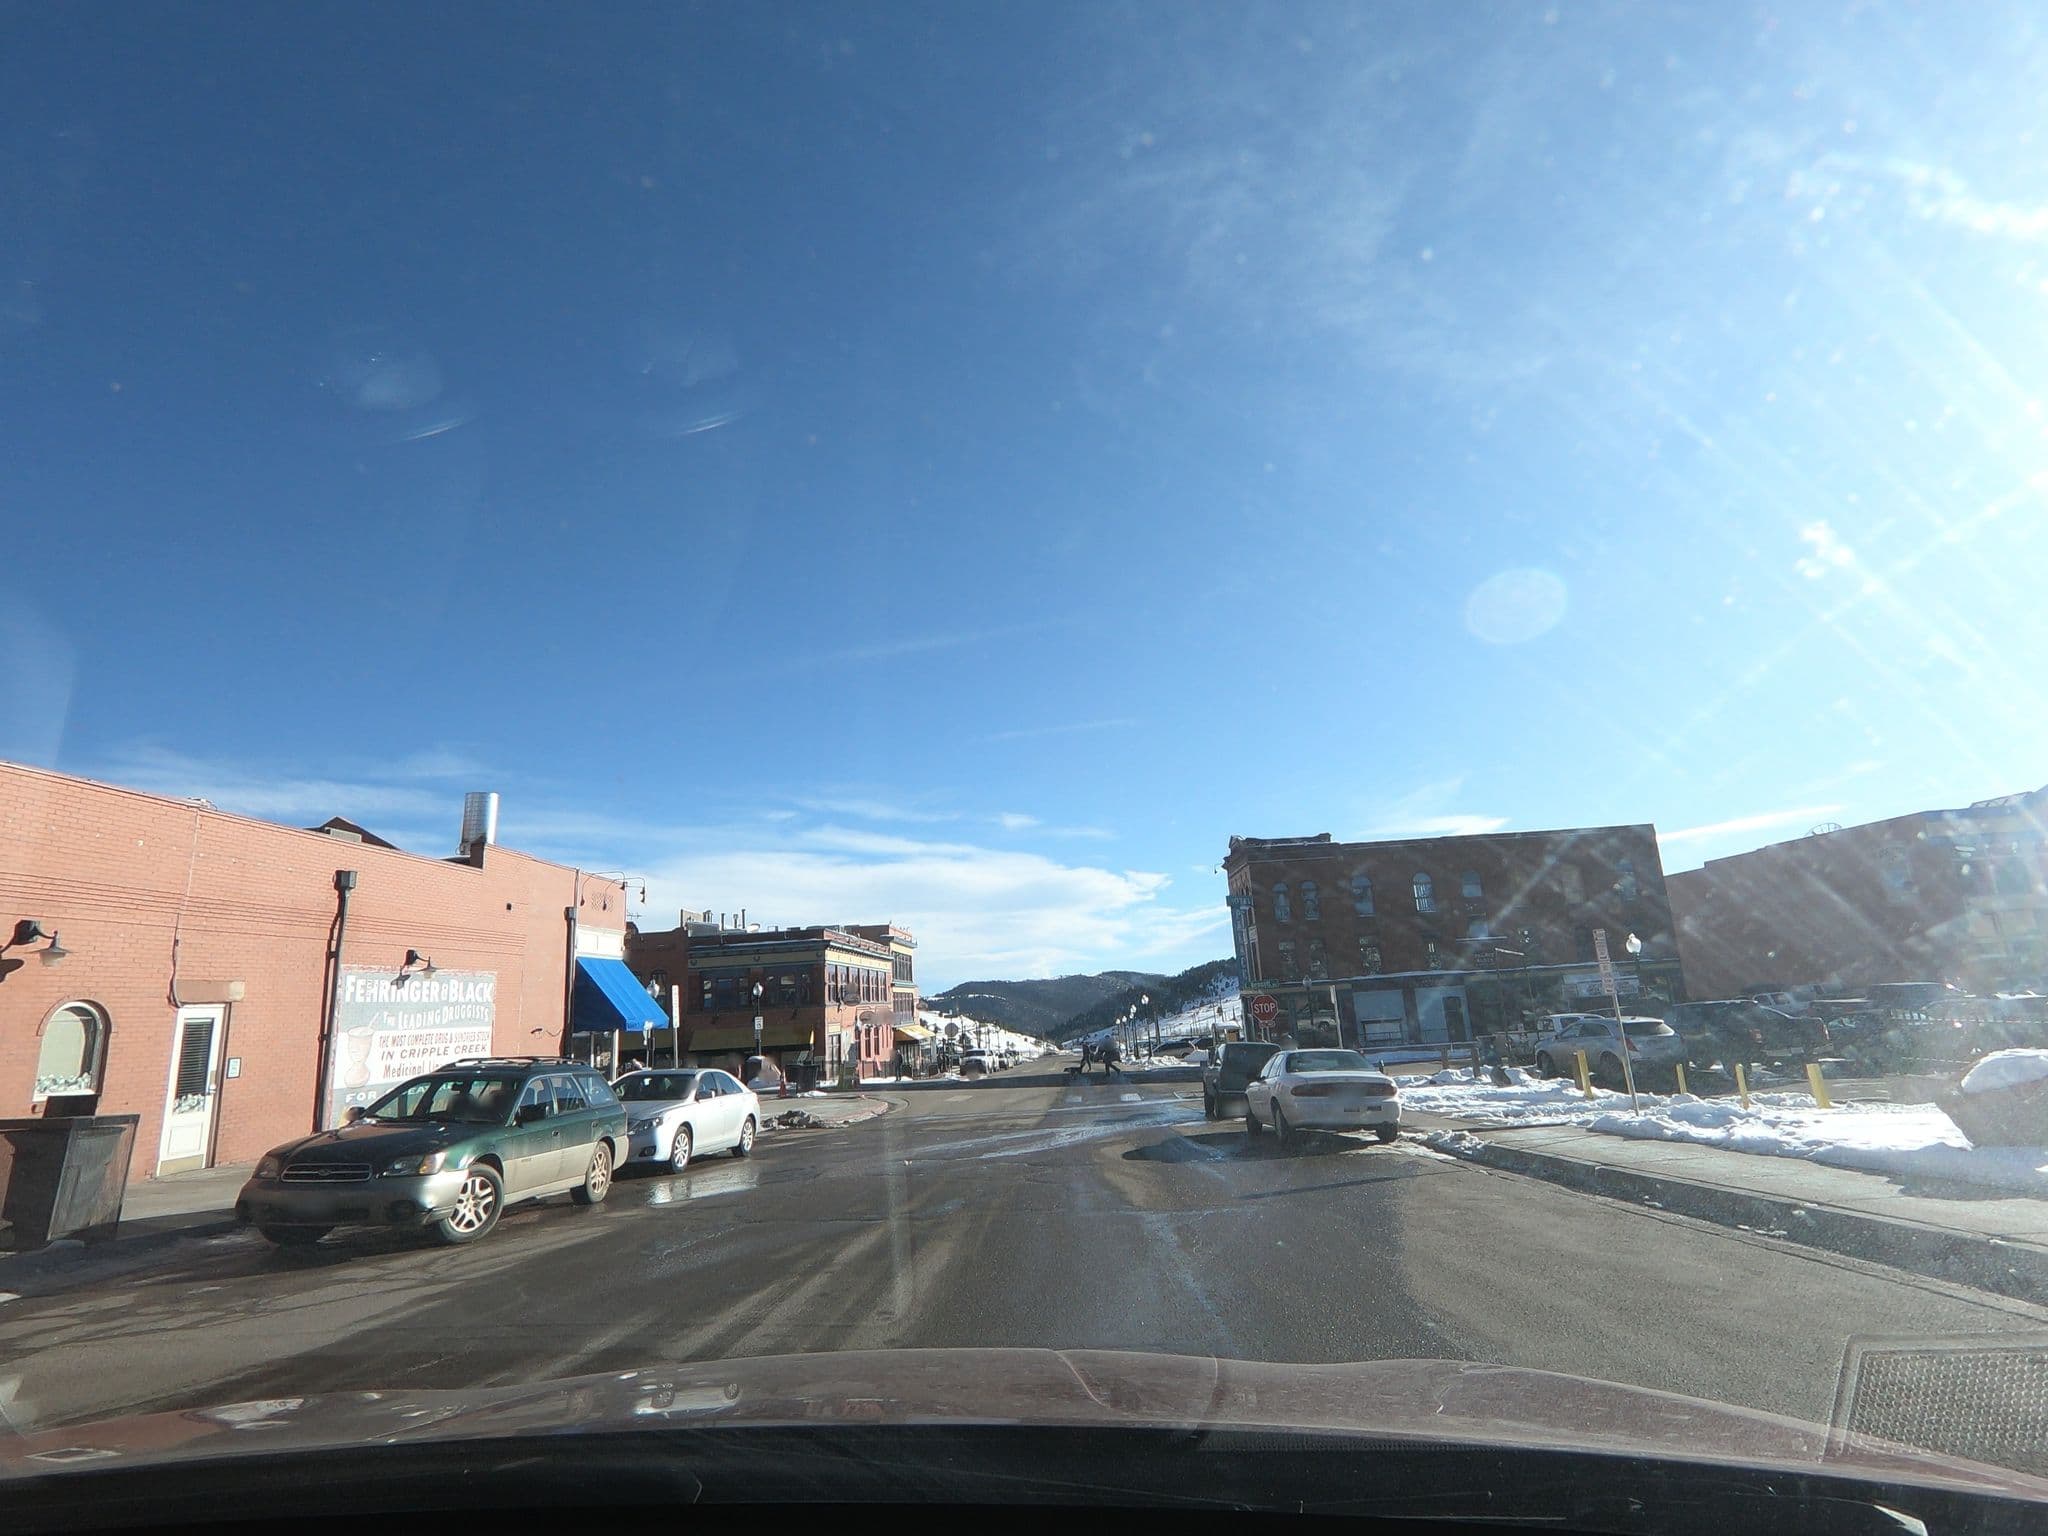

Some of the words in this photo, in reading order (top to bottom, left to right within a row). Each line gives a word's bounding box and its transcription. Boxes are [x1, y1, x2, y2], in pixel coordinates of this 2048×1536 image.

[345, 975, 443, 1002] FEHRINGER
[441, 985, 448, 999] &
[449, 979, 494, 1002] BLACK
[400, 1011, 440, 1030] LEADING
[442, 1004, 488, 1024] DRUGGISTS
[1254, 1003, 1275, 1014] STOP
[380, 1035, 389, 1048] THE
[392, 1034, 406, 1047] MOST
[408, 1033, 434, 1046] COMPLETE
[381, 1051, 394, 1061] IN
[400, 1046, 449, 1059] CRIPPLE
[454, 1044, 487, 1055] CREEK
[383, 1060, 425, 1080] Medicinal
[345, 1091, 377, 1103] FOR
